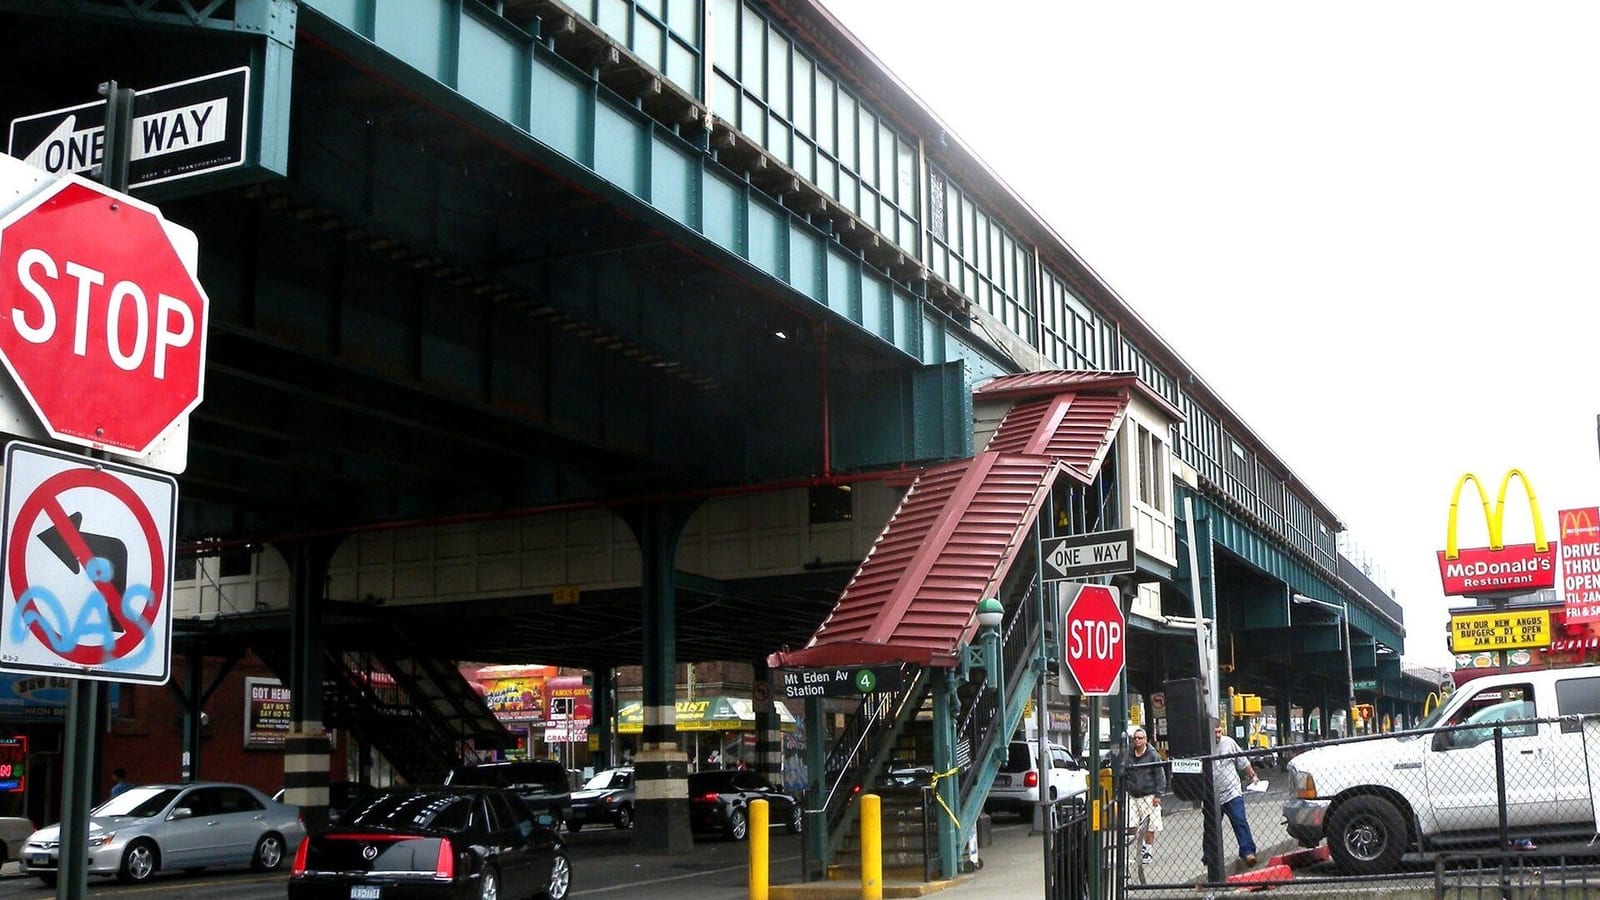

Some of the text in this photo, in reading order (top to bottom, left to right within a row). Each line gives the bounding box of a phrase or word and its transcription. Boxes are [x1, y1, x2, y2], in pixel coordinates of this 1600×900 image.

[45, 105, 213, 173] ONE WAY
[11, 248, 195, 380] STOP
[1055, 544, 1122, 567] ONE WAY
[1563, 543, 1600, 559] DRIVE
[1447, 557, 1550, 578] McDonald's
[1564, 558, 1600, 574] THRU
[1464, 574, 1533, 587] Restaurant
[1566, 574, 1600, 591] OPEN
[1566, 592, 1580, 603] TIL
[1566, 608, 1580, 618] FRI
[1582, 606, 1590, 616] &
[1456, 617, 1542, 630] TRY OUR NEW ANGUS
[1461, 625, 1542, 638] BURGERS DT OPEN
[1070, 619, 1121, 660] STOP
[1474, 634, 1536, 645] 2AM FRI & SAT
[2, 653, 20, 662] R3-2
[784, 670, 849, 685] Mt Eden Av
[860, 674, 871, 688] 4
[252, 687, 269, 699] GOT
[786, 684, 825, 698] Station
